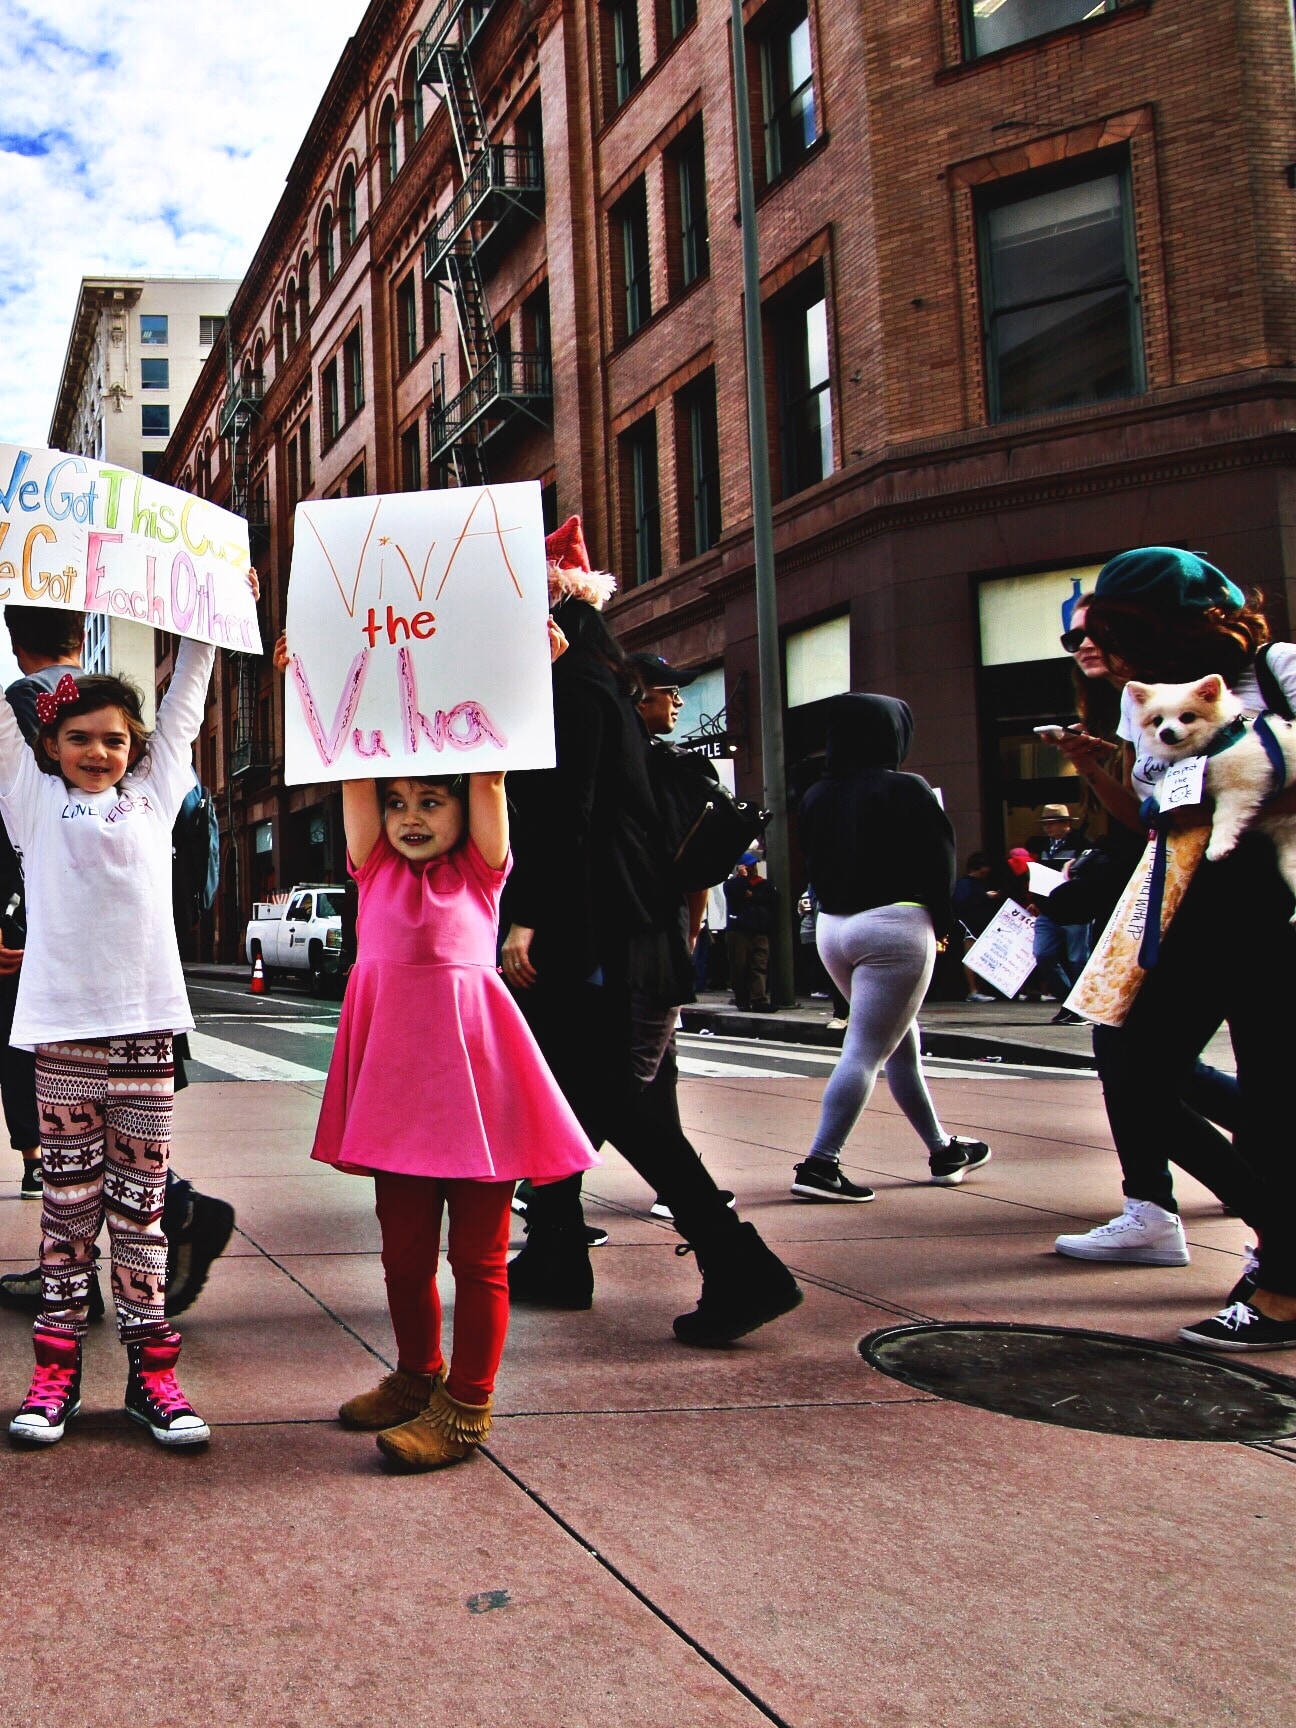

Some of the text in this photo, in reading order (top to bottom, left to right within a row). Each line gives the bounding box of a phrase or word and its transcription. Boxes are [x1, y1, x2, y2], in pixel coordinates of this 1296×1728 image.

[44, 458, 99, 525] Got
[99, 470, 178, 543] This
[22, 524, 78, 603] Got
[84, 532, 165, 626] Each
[171, 551, 254, 649] Other
[362, 606, 436, 648] the
[1011, 908, 1037, 928] OSER
